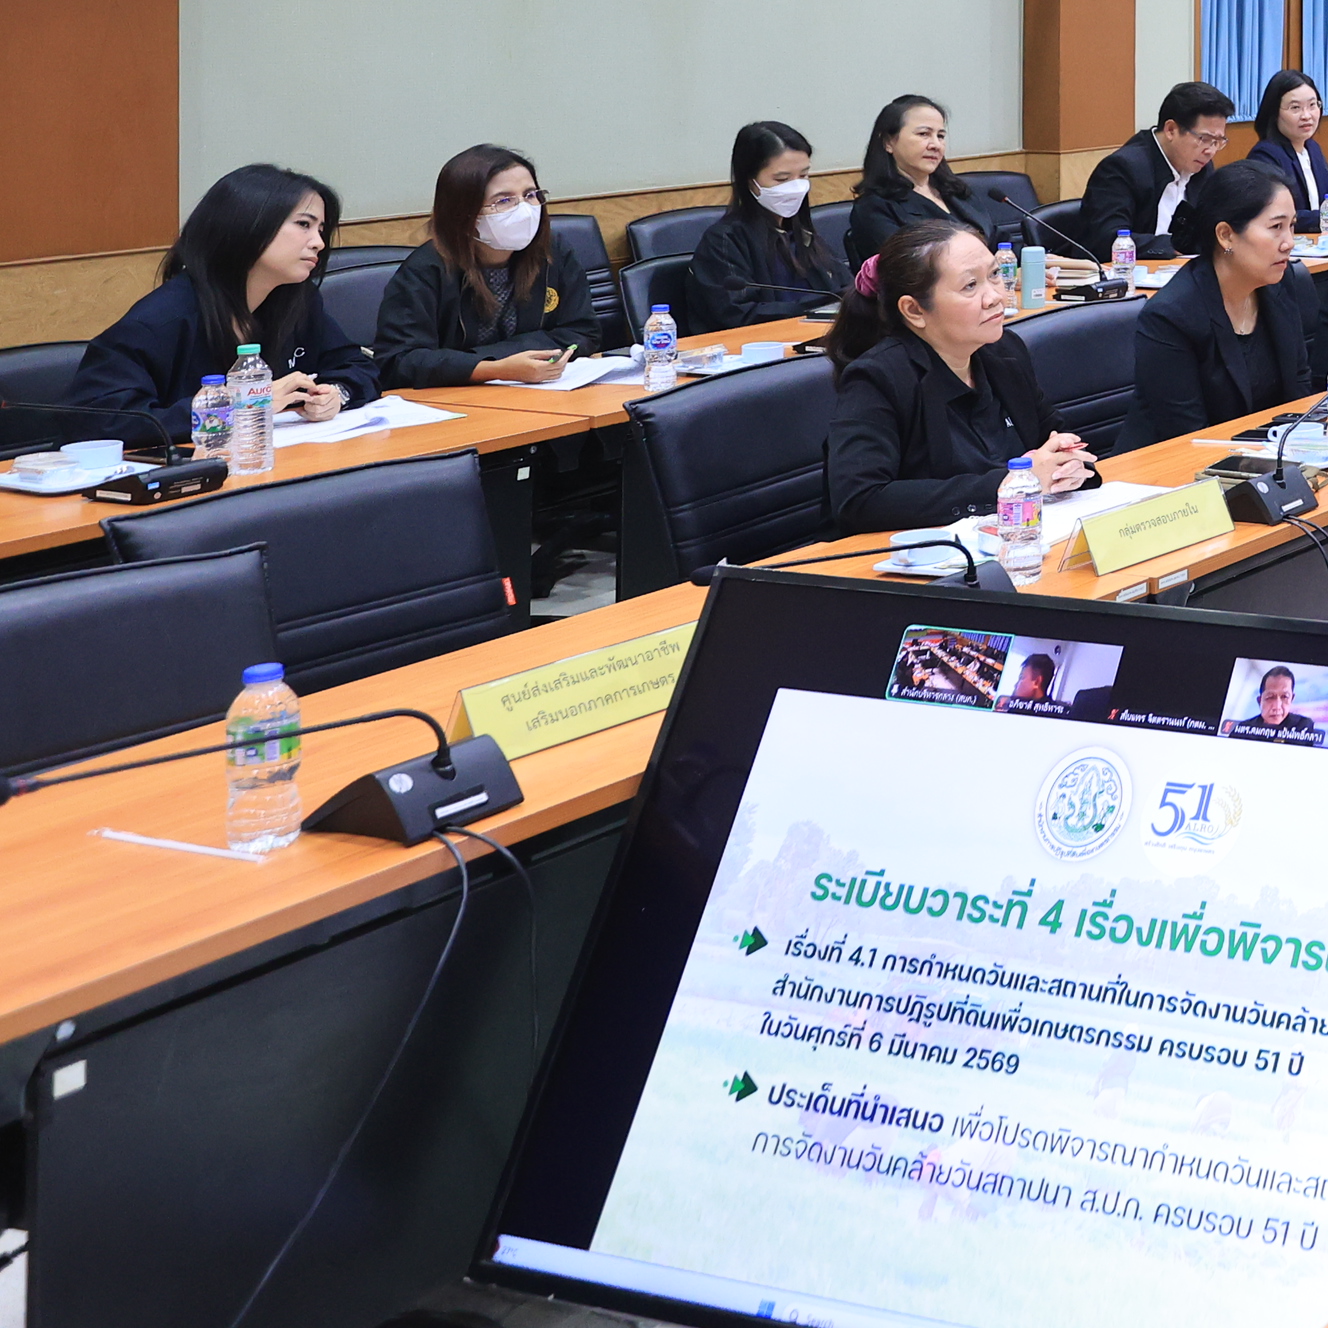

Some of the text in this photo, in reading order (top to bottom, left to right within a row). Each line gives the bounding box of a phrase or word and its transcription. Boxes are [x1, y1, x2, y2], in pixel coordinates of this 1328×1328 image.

[1118, 503, 1199, 539] กลุ่มตรวจสอบภายใน
[500, 639, 681, 712] ศูนย์ส่งเสริมและพัฒนาอาชีพ
[525, 671, 676, 732] เสริมนอกภาคการเกษตร
[1151, 781, 1214, 837] 51
[1185, 822, 1214, 834] ALRO
[810, 868, 1036, 930] ระเบียบวาระที่
[1038, 899, 1065, 935] 4
[784, 927, 848, 964] เรื่องที่
[848, 946, 878, 968] 4.1
[759, 1011, 1020, 1075] ในวันศุกร์ที่ 6 มีนาคม 2569
[772, 972, 1305, 1077] สำนักงานการปฏิรูปที่ดินเพื่อเกษตรกรรม ครบรอบ 51 ปี
[767, 1082, 945, 1133] ประเด็นที่นำเสนอ
[751, 1131, 1320, 1252] การจัดงานวันคล้ายวันสถาปนา ส.ป.ก. ครบรอบ 51 ปี
